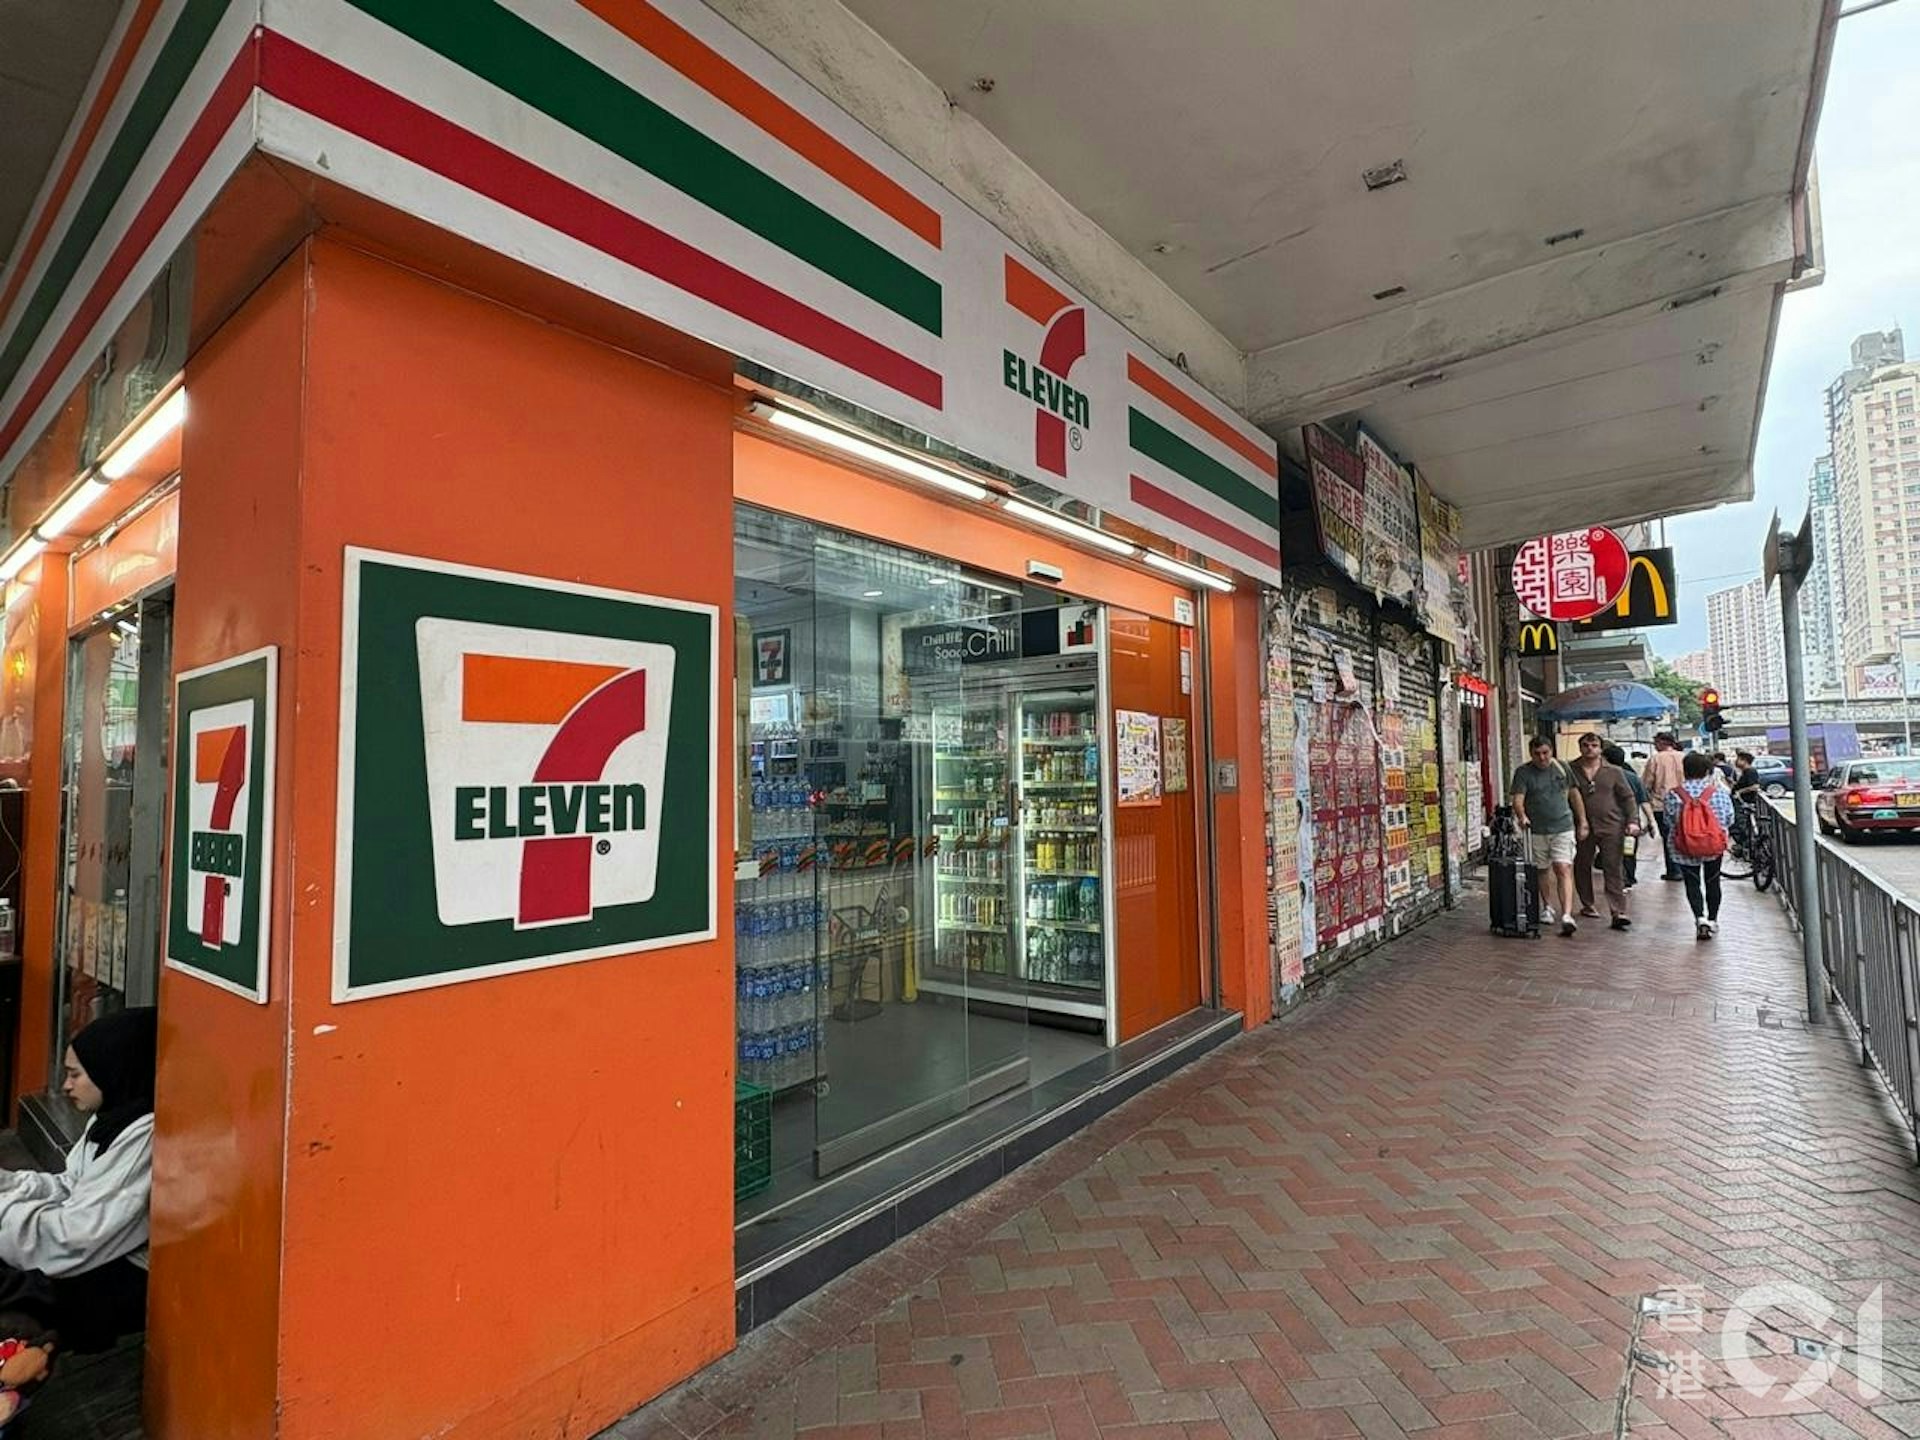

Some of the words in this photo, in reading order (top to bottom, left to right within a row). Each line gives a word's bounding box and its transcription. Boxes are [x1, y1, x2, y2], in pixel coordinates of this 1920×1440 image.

[1004, 253, 1087, 478] 7
[968, 630, 1015, 656] Chill
[461, 652, 647, 926] 7
